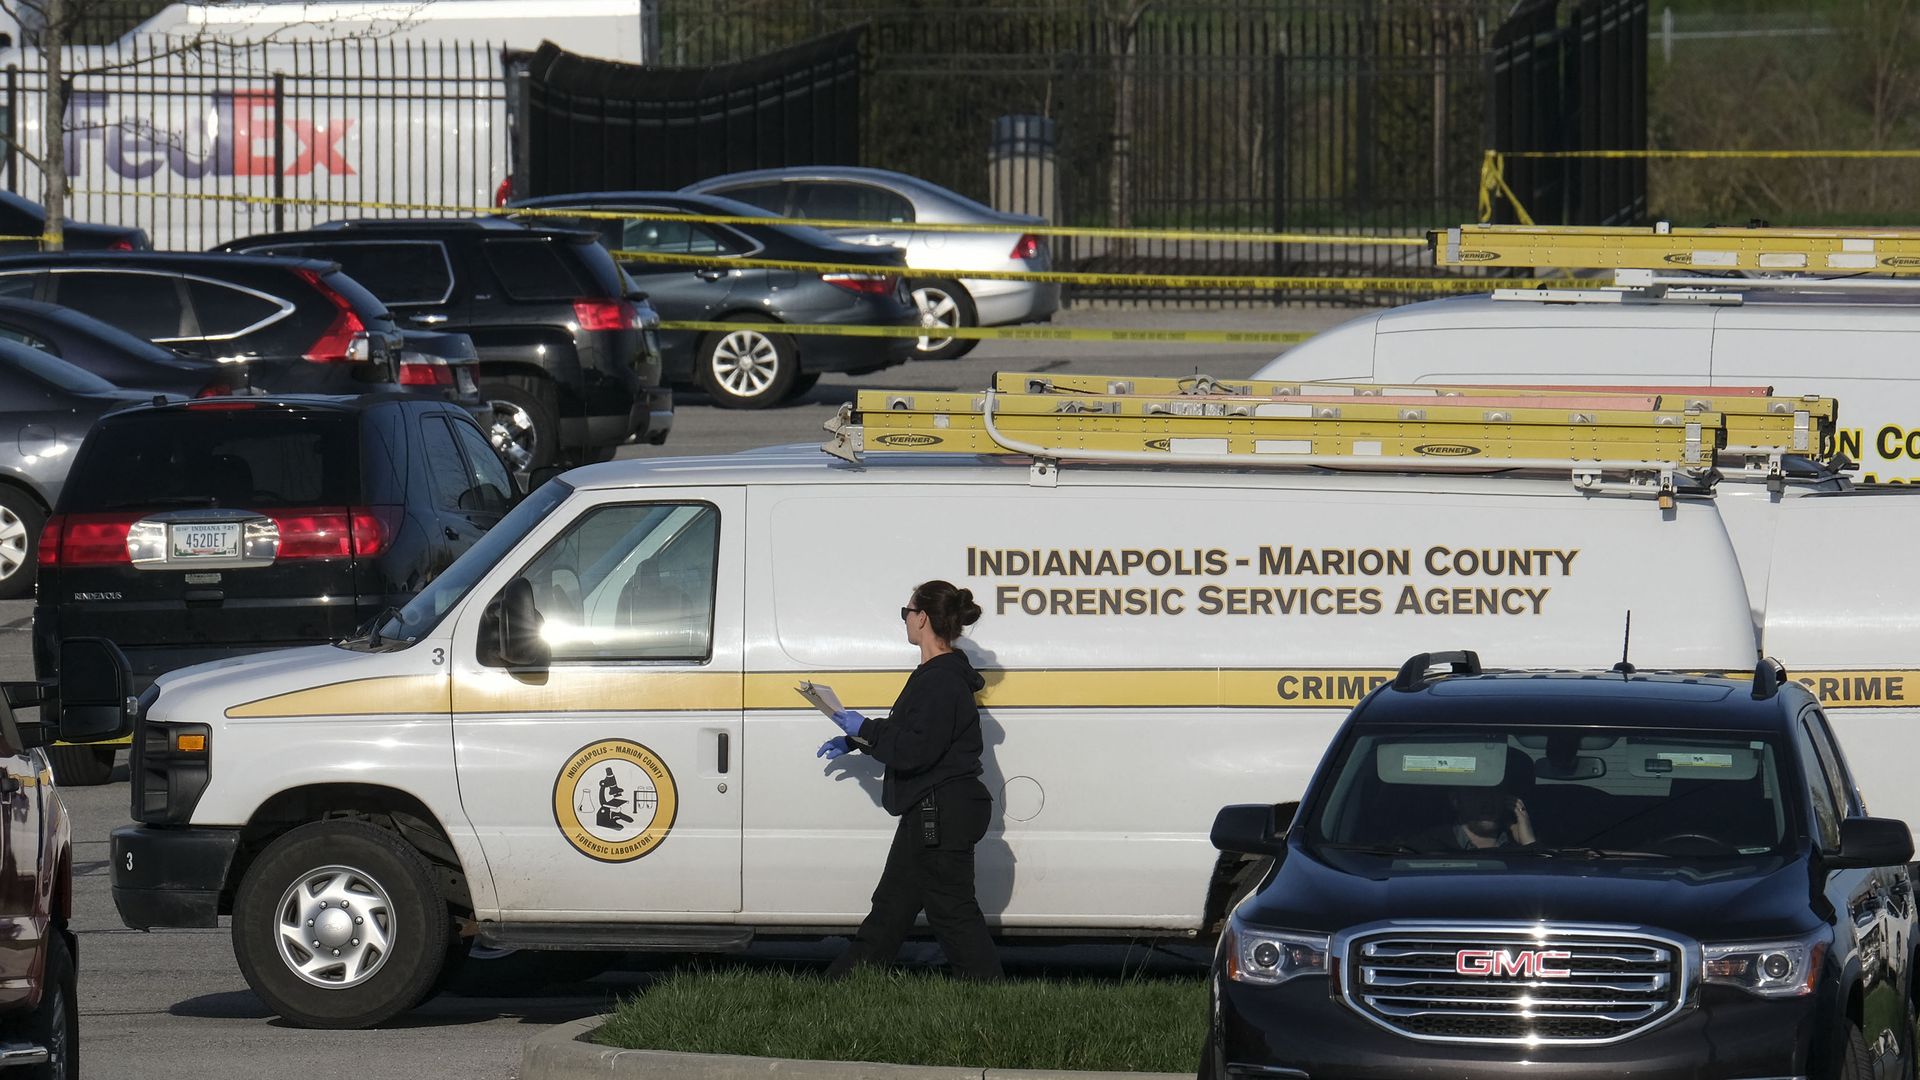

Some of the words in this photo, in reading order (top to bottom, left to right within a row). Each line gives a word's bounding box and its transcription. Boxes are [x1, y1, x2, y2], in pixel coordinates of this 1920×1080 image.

[63, 89, 358, 179] FedEx
[186, 532, 227, 548] 452DET
[967, 546, 1229, 577] INDIANAPOLIS
[1258, 545, 1411, 577] MARION
[1424, 545, 1580, 577] COUNTY
[996, 585, 1184, 616] FORENSIC
[1197, 585, 1382, 616] SERVICES
[1394, 584, 1550, 615] AGENCY
[432, 648, 445, 665] 3
[566, 746, 608, 779] INDIANAPOLIS
[615, 745, 643, 759] MARION
[642, 756, 664, 780] COUNTY
[575, 833, 609, 854] FORENSIC
[610, 833, 654, 855] LABORATORY
[126, 852, 133, 871] 3
[1456, 949, 1572, 978] GMC
